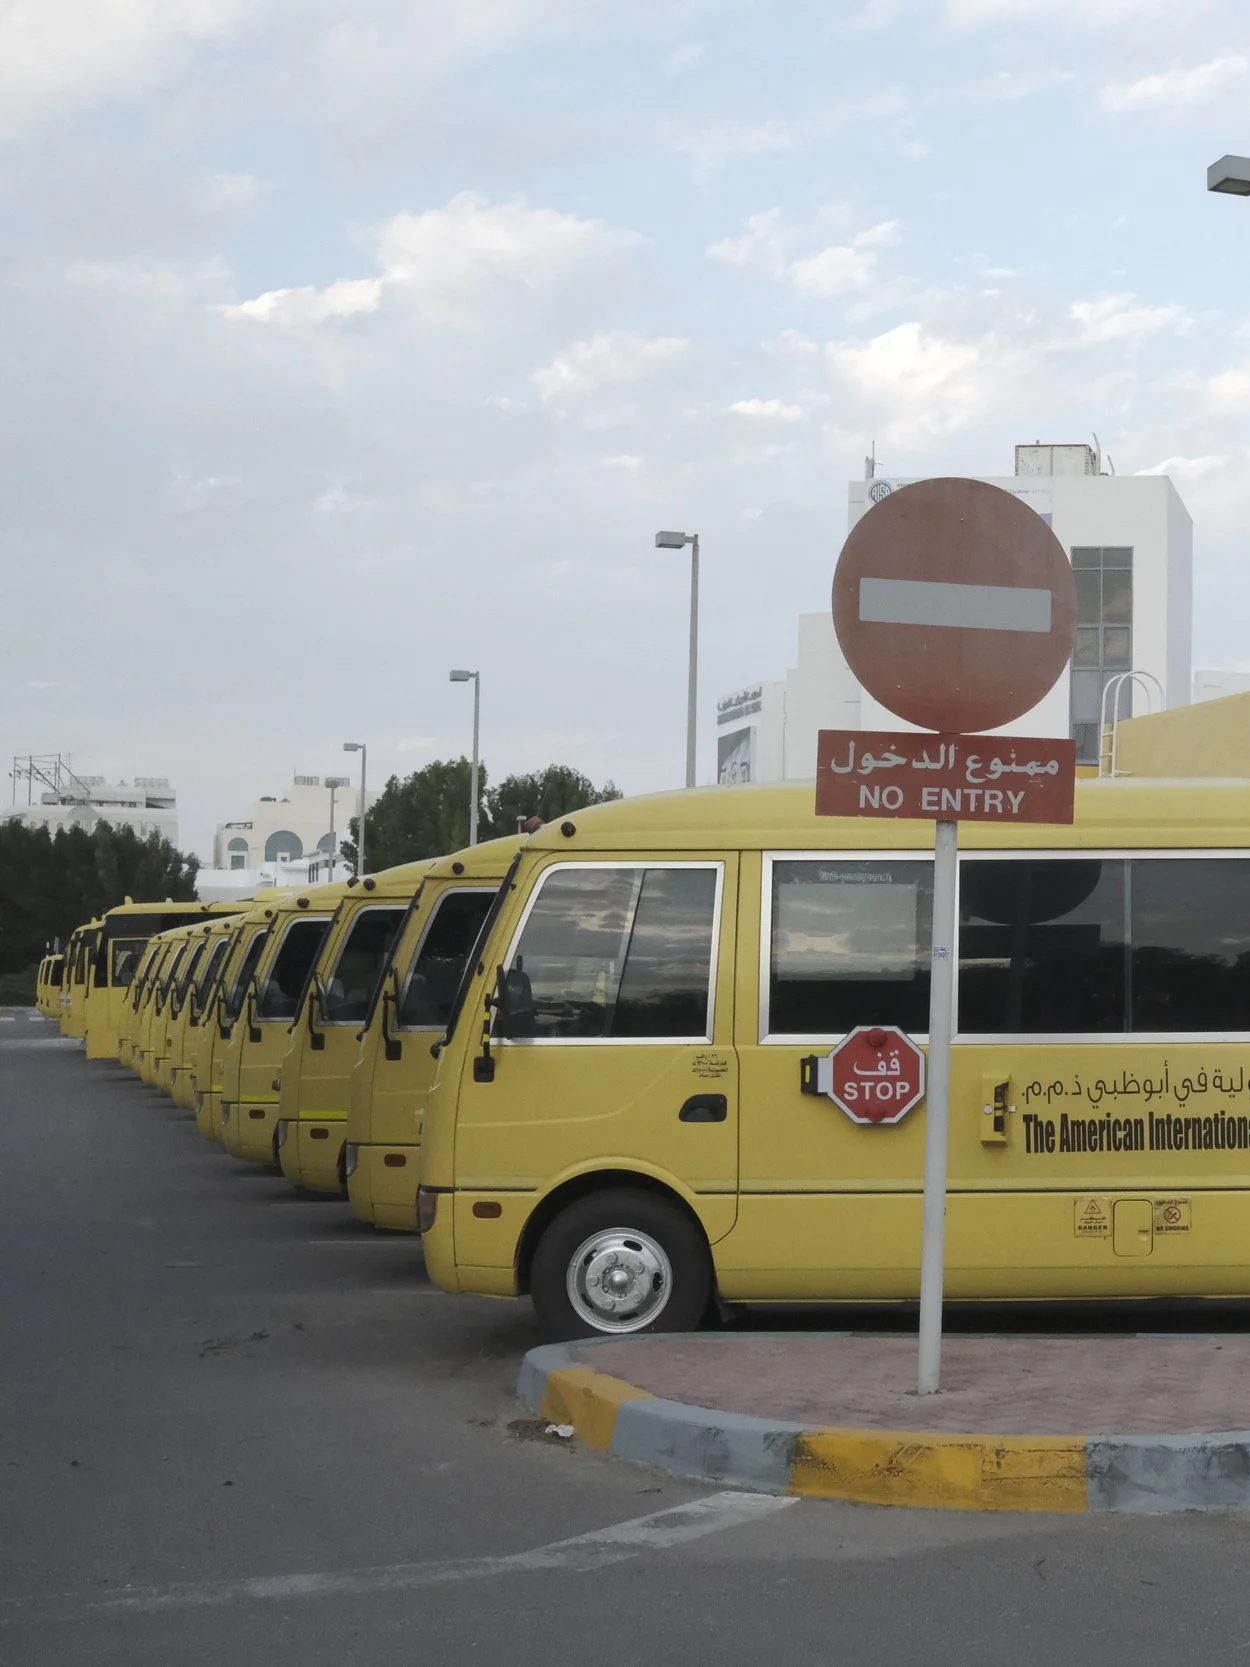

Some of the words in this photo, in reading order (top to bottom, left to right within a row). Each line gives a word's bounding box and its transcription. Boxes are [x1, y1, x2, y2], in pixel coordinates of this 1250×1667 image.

[831, 741, 956, 774] الدخول
[966, 750, 1058, 783] ممنوع
[860, 786, 903, 809] NO
[921, 788, 1024, 813] ENTRY
[854, 1050, 900, 1075] قف
[843, 1082, 910, 1100] STOP
[1087, 1060, 1168, 1109] أبوظبي
[1174, 1067, 1207, 1107] في
[1023, 1114, 1055, 1153] The
[1060, 1112, 1144, 1152] American
